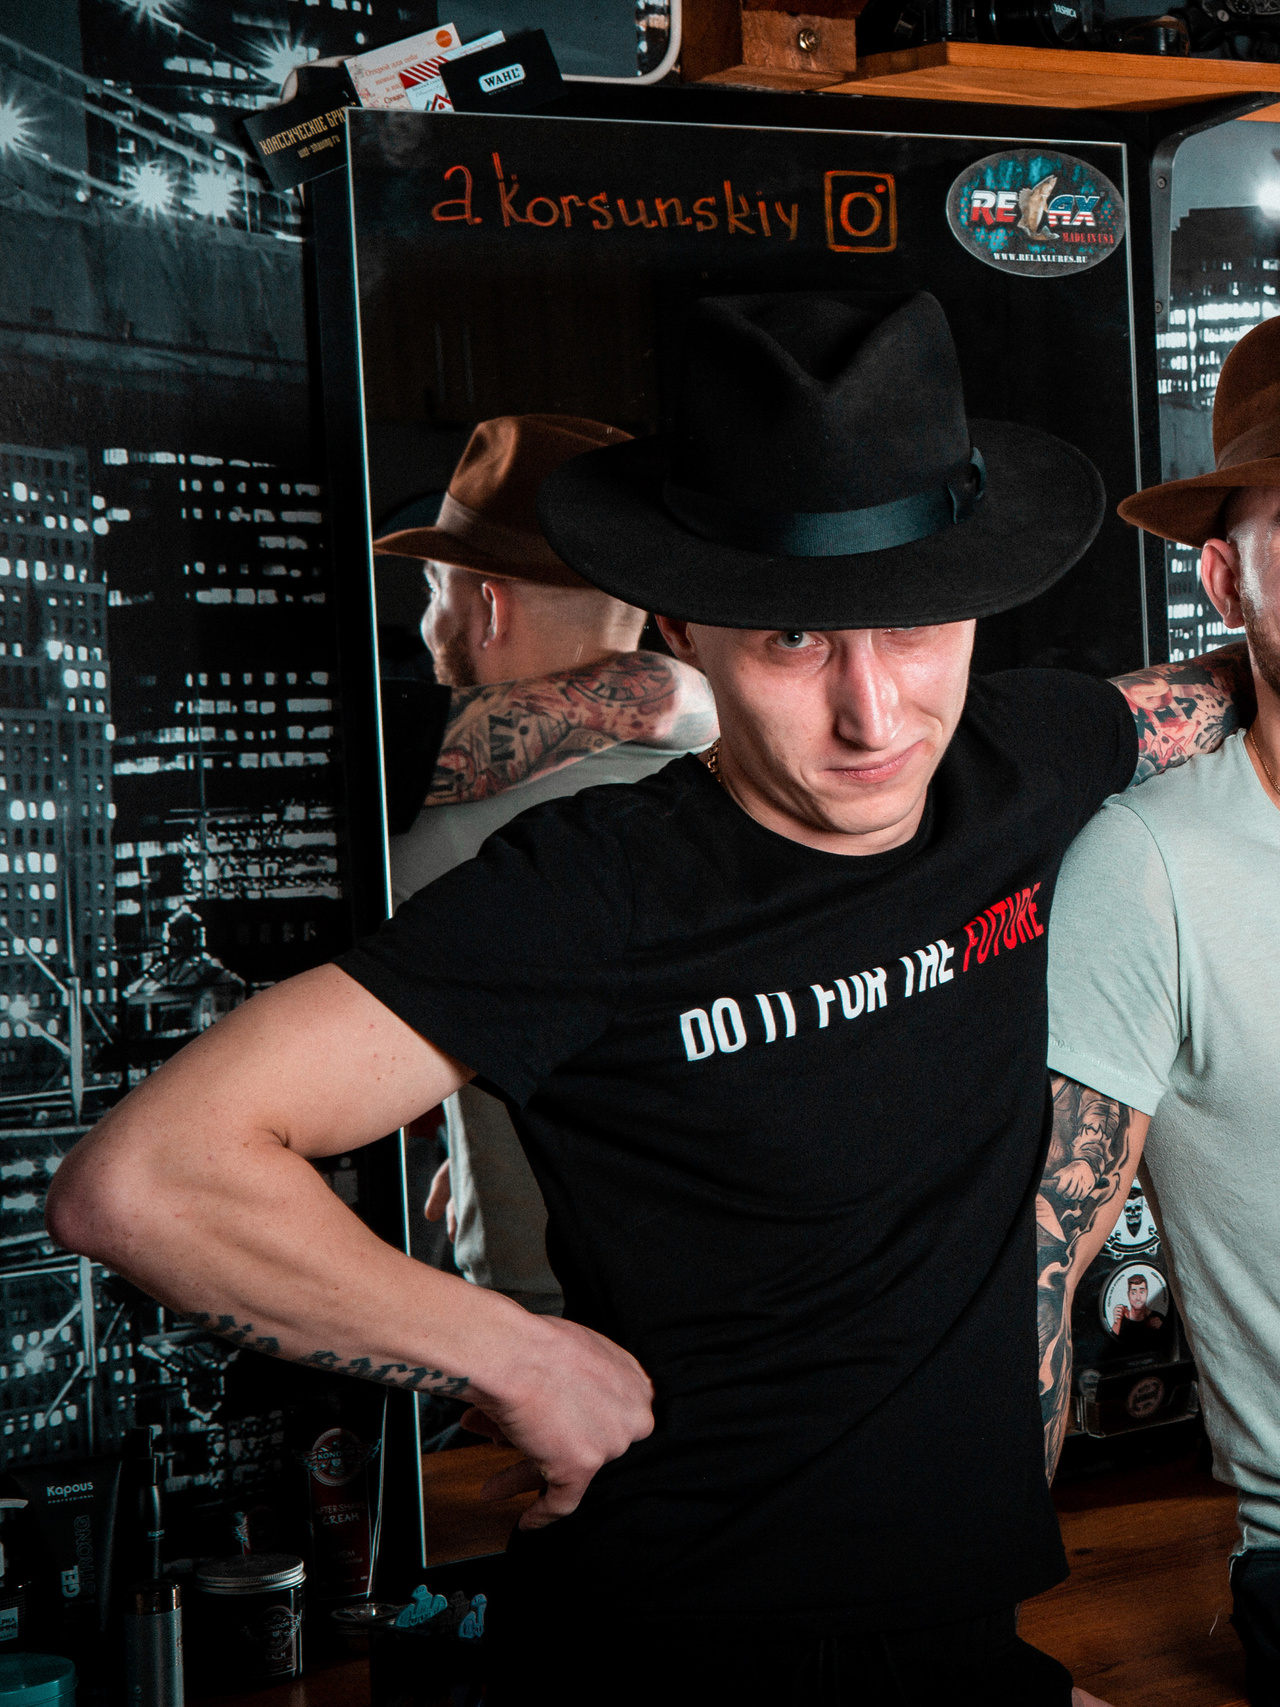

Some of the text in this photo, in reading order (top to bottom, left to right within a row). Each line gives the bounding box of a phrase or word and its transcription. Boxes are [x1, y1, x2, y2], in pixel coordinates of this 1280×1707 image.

[483, 67, 520, 88] WAHL
[1062, 232, 1086, 243] MADE
[1098, 234, 1115, 244] USA
[993, 252, 1089, 264] WWW.RELAXLURES.RU
[679, 881, 1045, 1062] DO IT FOR THE FUTURE
[46, 1480, 94, 1498] Kapous
[321, 1512, 361, 1526] CREAM
[60, 1564, 81, 1599] GEL
